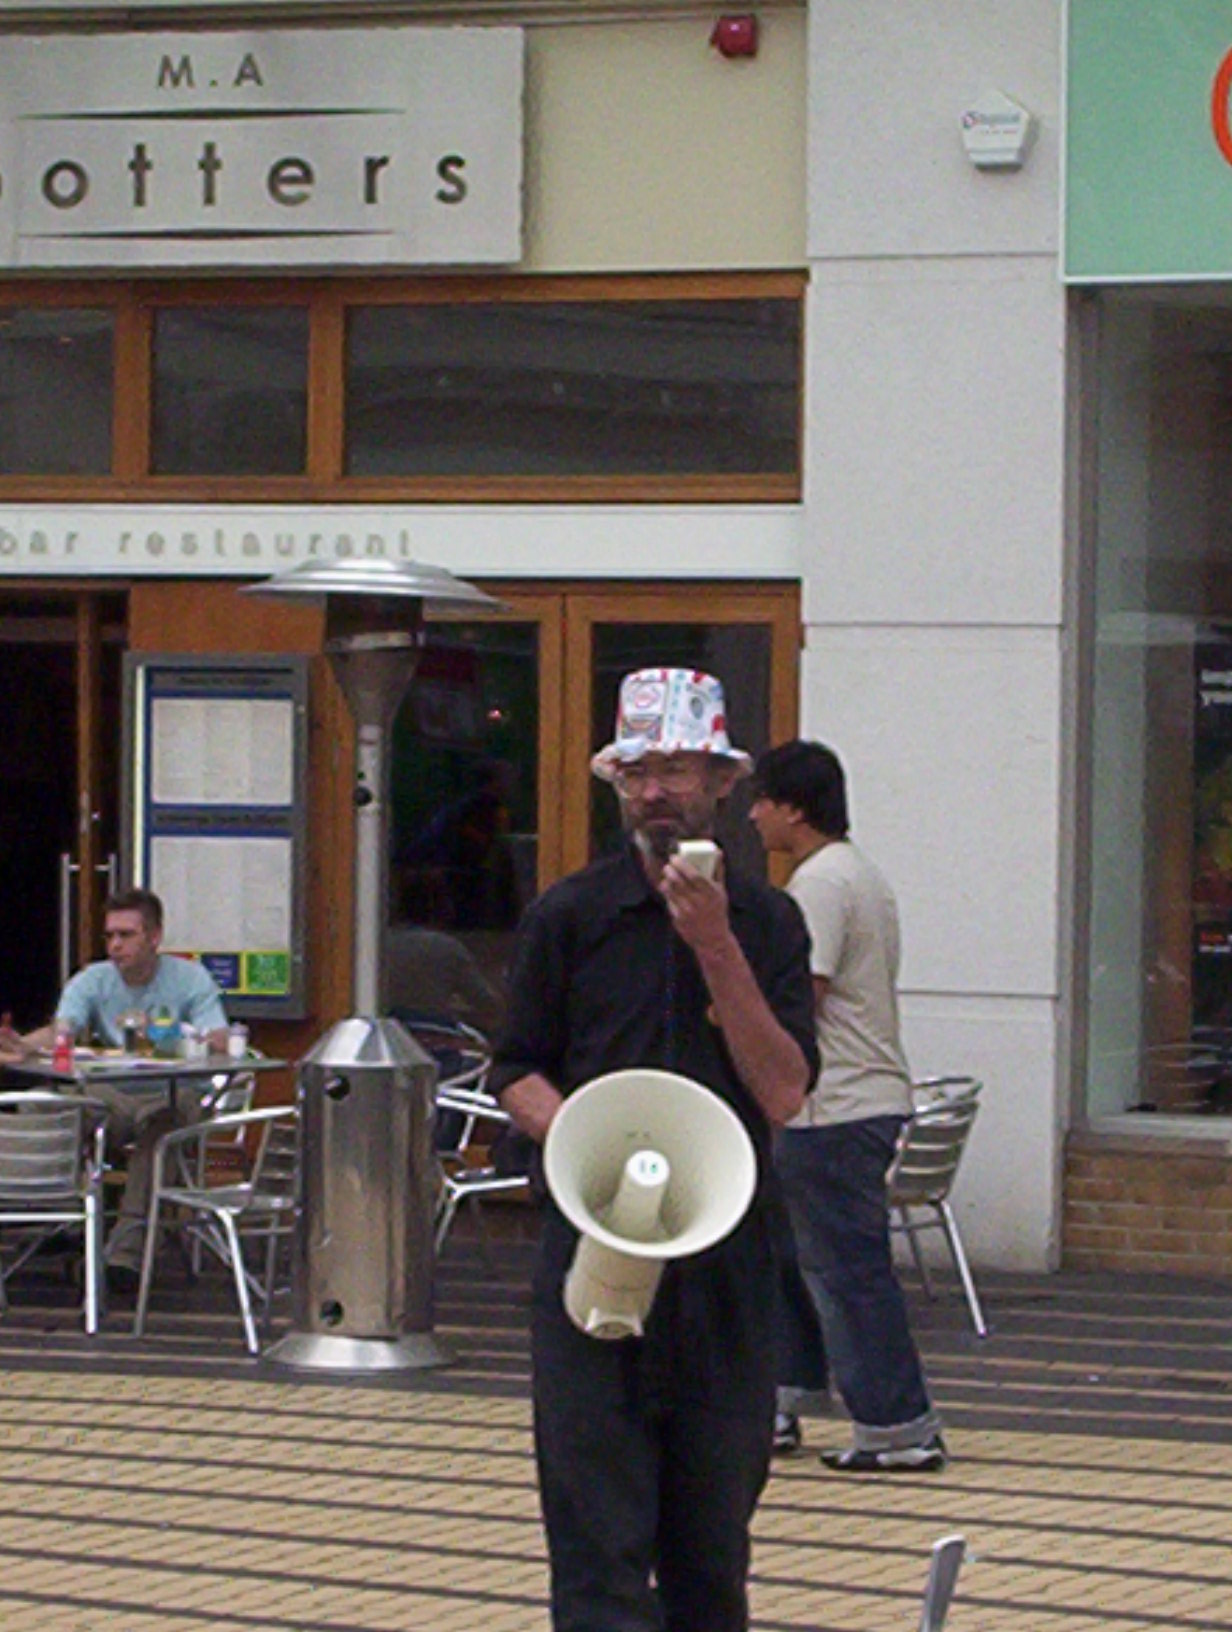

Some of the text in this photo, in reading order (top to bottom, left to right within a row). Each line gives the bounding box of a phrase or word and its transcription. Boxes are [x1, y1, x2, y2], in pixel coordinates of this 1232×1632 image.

[0, 142, 468, 208] otters
[0, 527, 410, 557] bar restaurant
